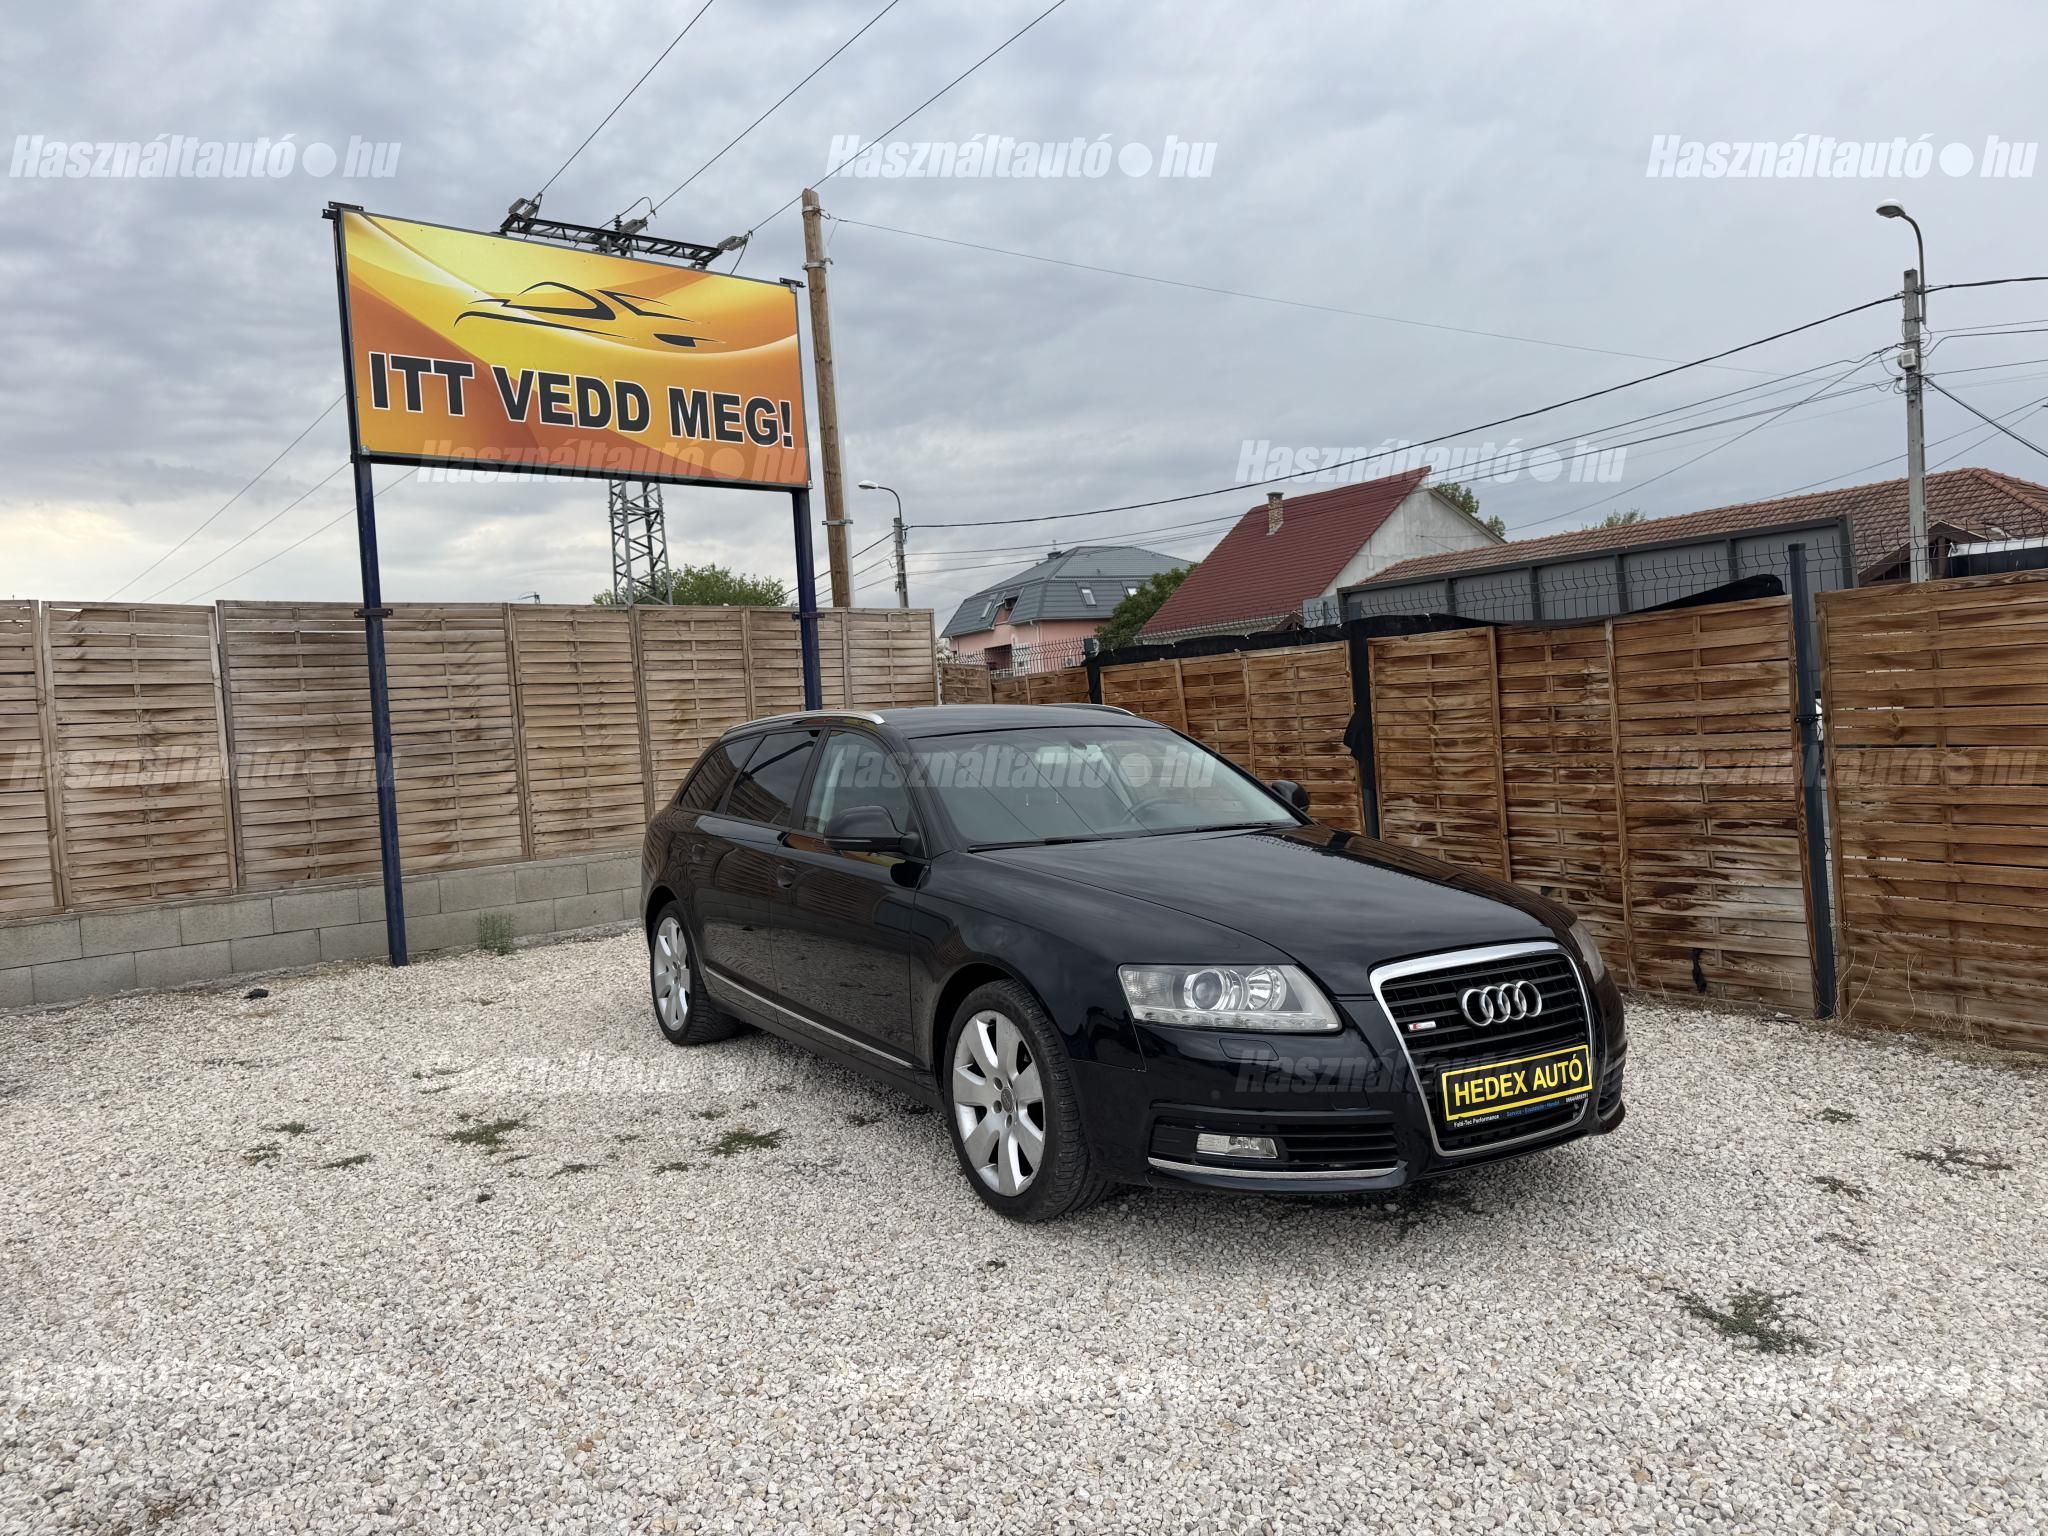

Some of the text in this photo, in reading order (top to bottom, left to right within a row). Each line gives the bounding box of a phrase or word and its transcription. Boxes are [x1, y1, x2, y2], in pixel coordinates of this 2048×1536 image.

[368, 350, 795, 450] ITT VEDD MEG!
[1454, 1053, 1583, 1107] HEDEX AUTÓ
